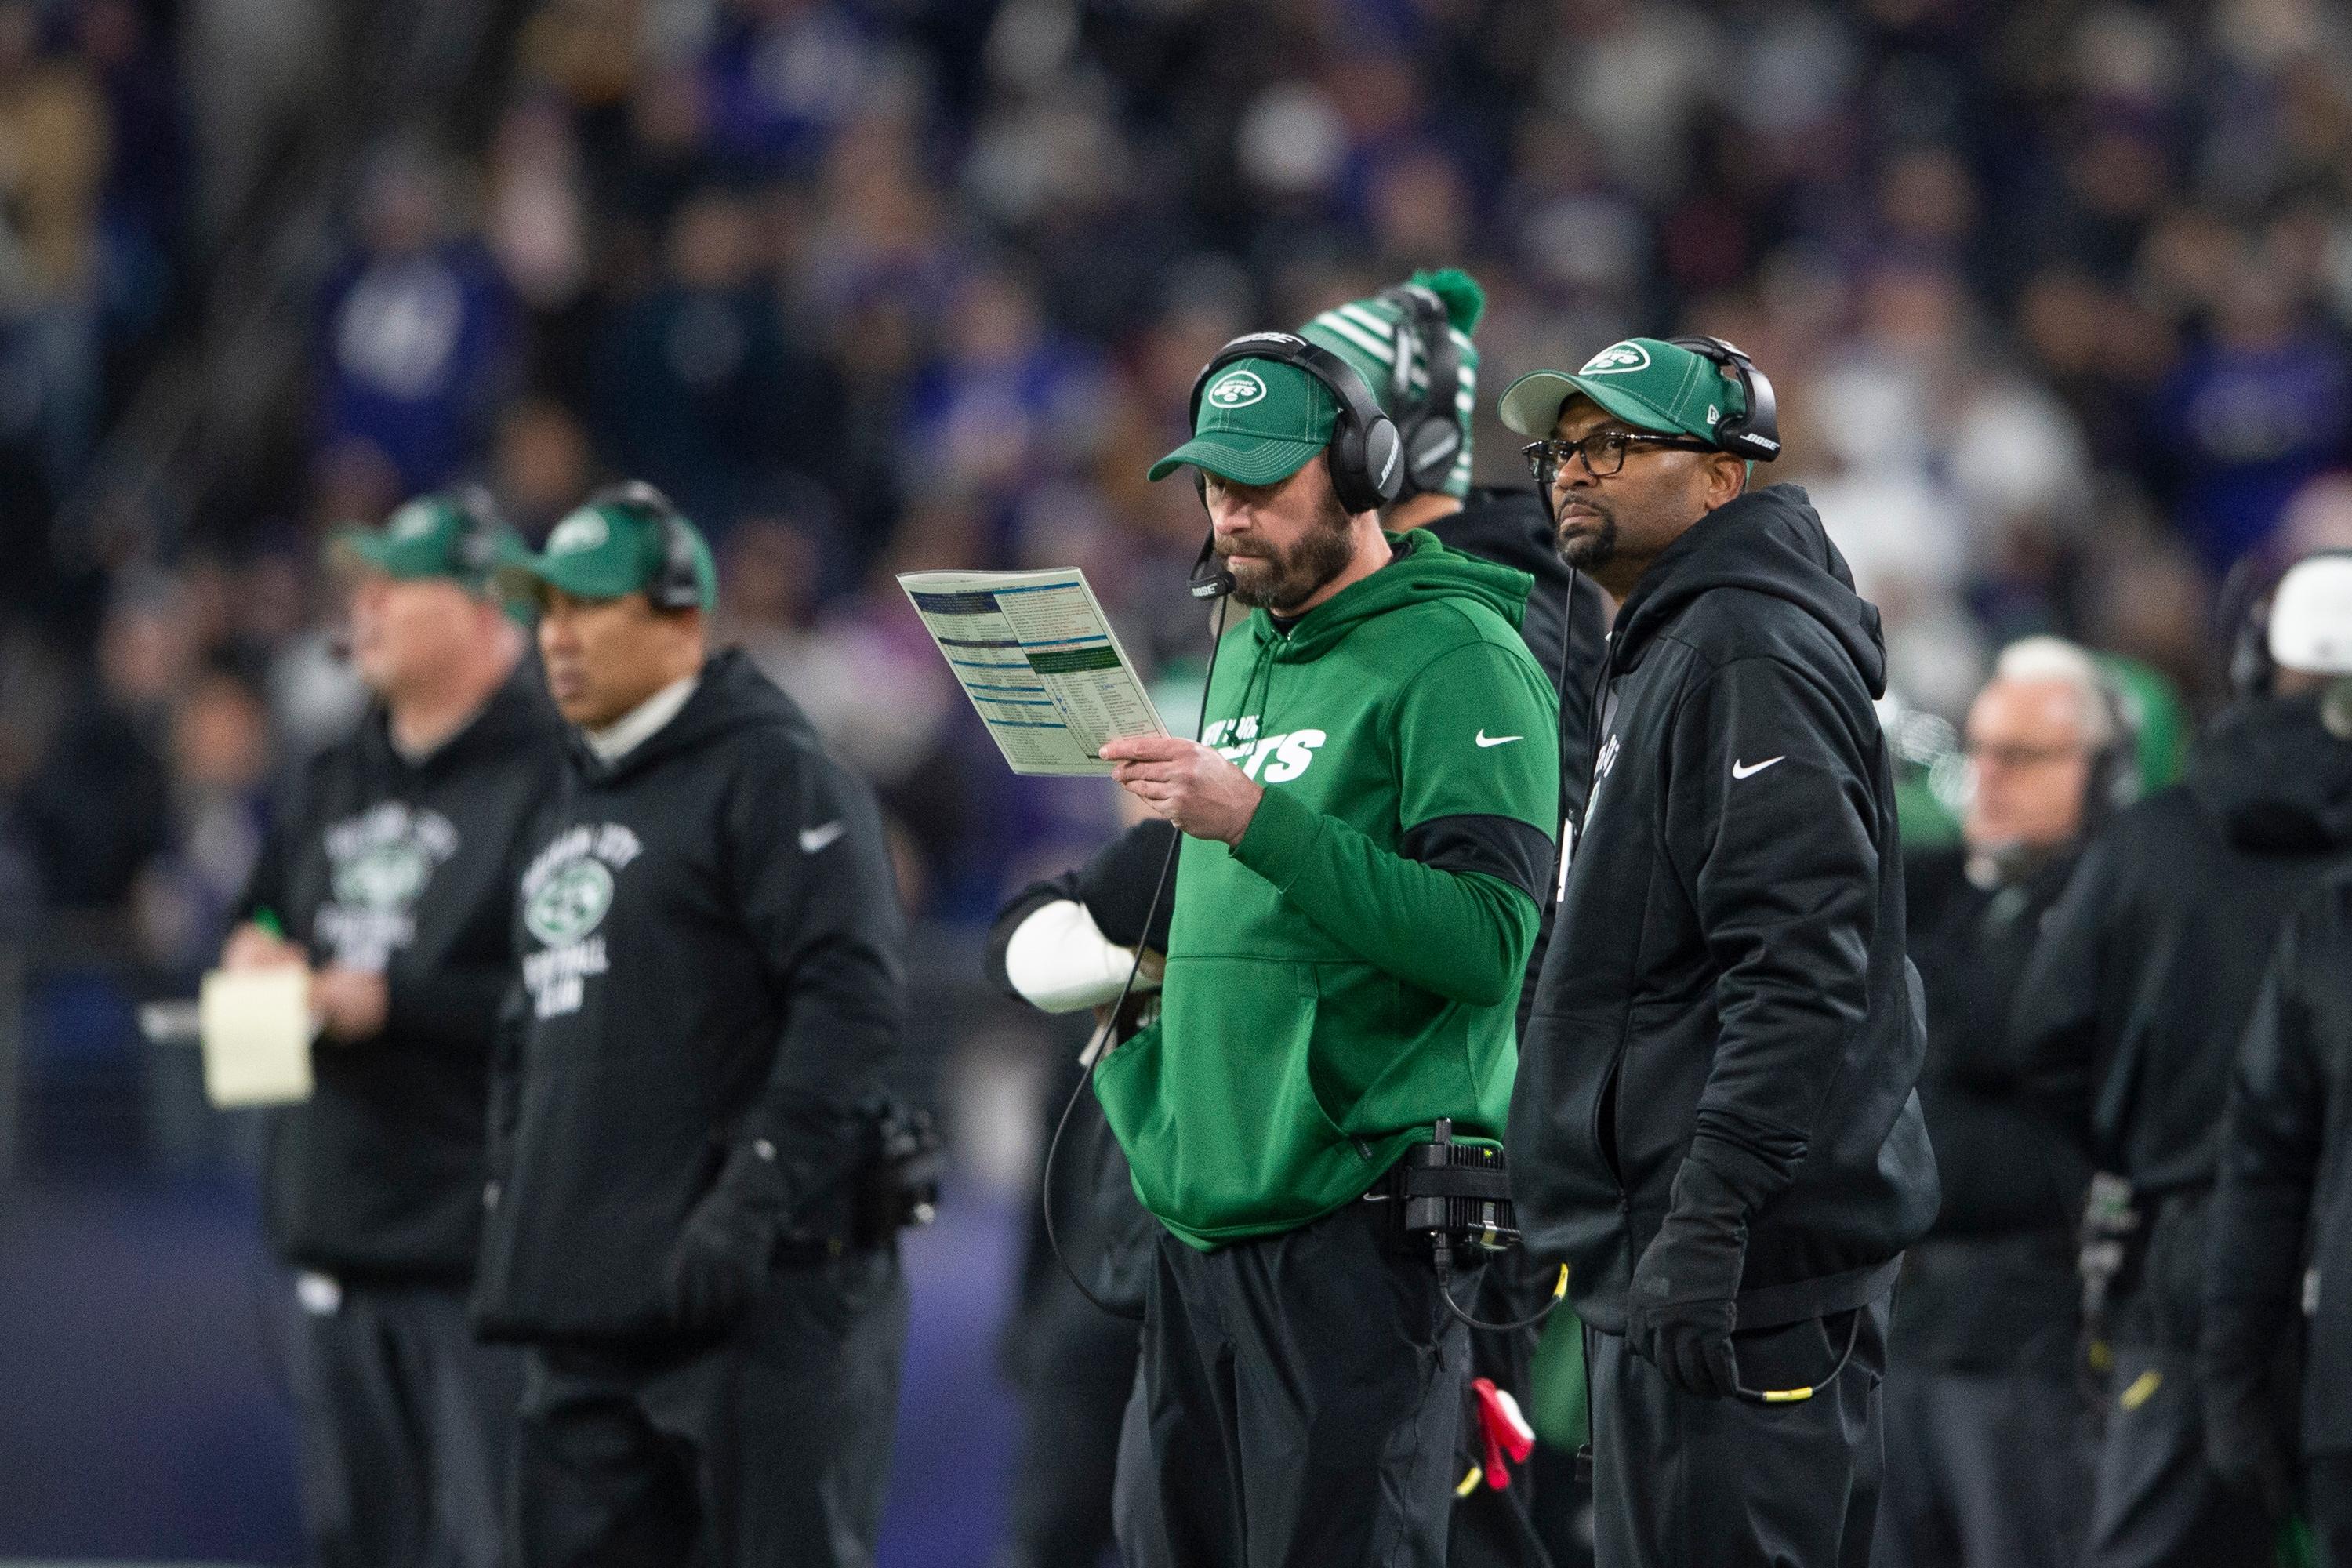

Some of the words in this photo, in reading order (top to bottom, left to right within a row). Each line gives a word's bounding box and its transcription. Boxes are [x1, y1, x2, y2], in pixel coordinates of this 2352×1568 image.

[1214, 384, 1258, 397] JETS
[1739, 432, 1780, 451] BOSE
[1192, 583, 1218, 597] BOSE
